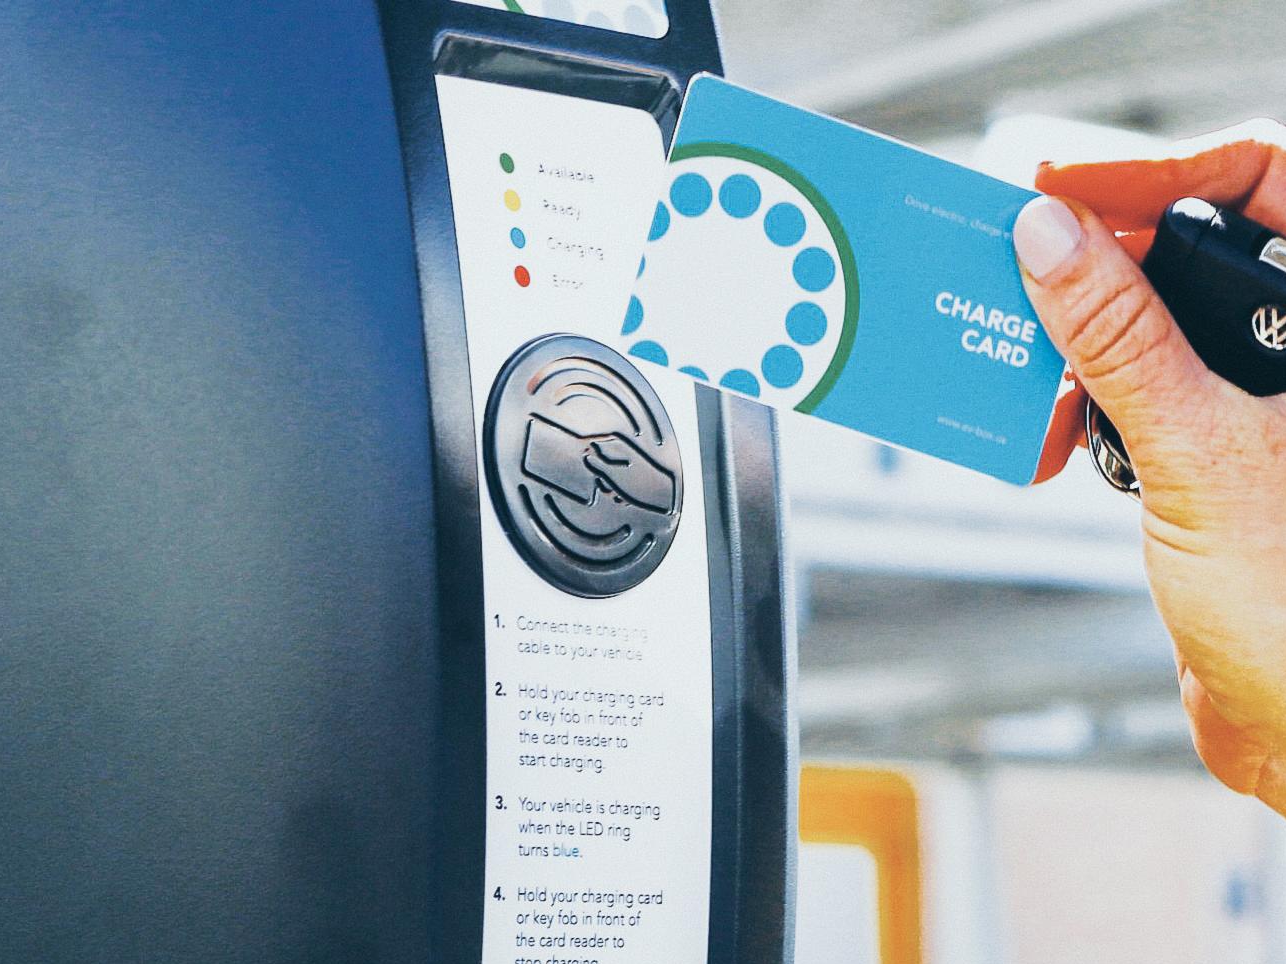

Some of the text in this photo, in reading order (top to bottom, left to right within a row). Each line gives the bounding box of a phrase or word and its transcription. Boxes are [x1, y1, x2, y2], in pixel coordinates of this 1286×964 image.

[935, 291, 1038, 344] CHARGE
[961, 330, 1029, 368] CARD
[494, 615, 505, 629] 1.
[517, 616, 569, 634] Connect
[573, 619, 591, 635] the
[517, 640, 550, 654] cable
[555, 643, 567, 656] to
[570, 646, 598, 661] your
[495, 682, 665, 708] 2. Hold your charging card
[518, 706, 643, 727] or key fob in front of
[519, 731, 628, 748] the card reader to
[519, 753, 545, 767] start
[495, 795, 660, 821] 3. Your vehicle is charging
[518, 821, 631, 841] when the LED ring
[518, 843, 582, 858] turns blue.
[493, 887, 663, 908] 4. Hold your charging card
[516, 910, 641, 928] or key fob in front of
[516, 933, 625, 948] the card reader to
